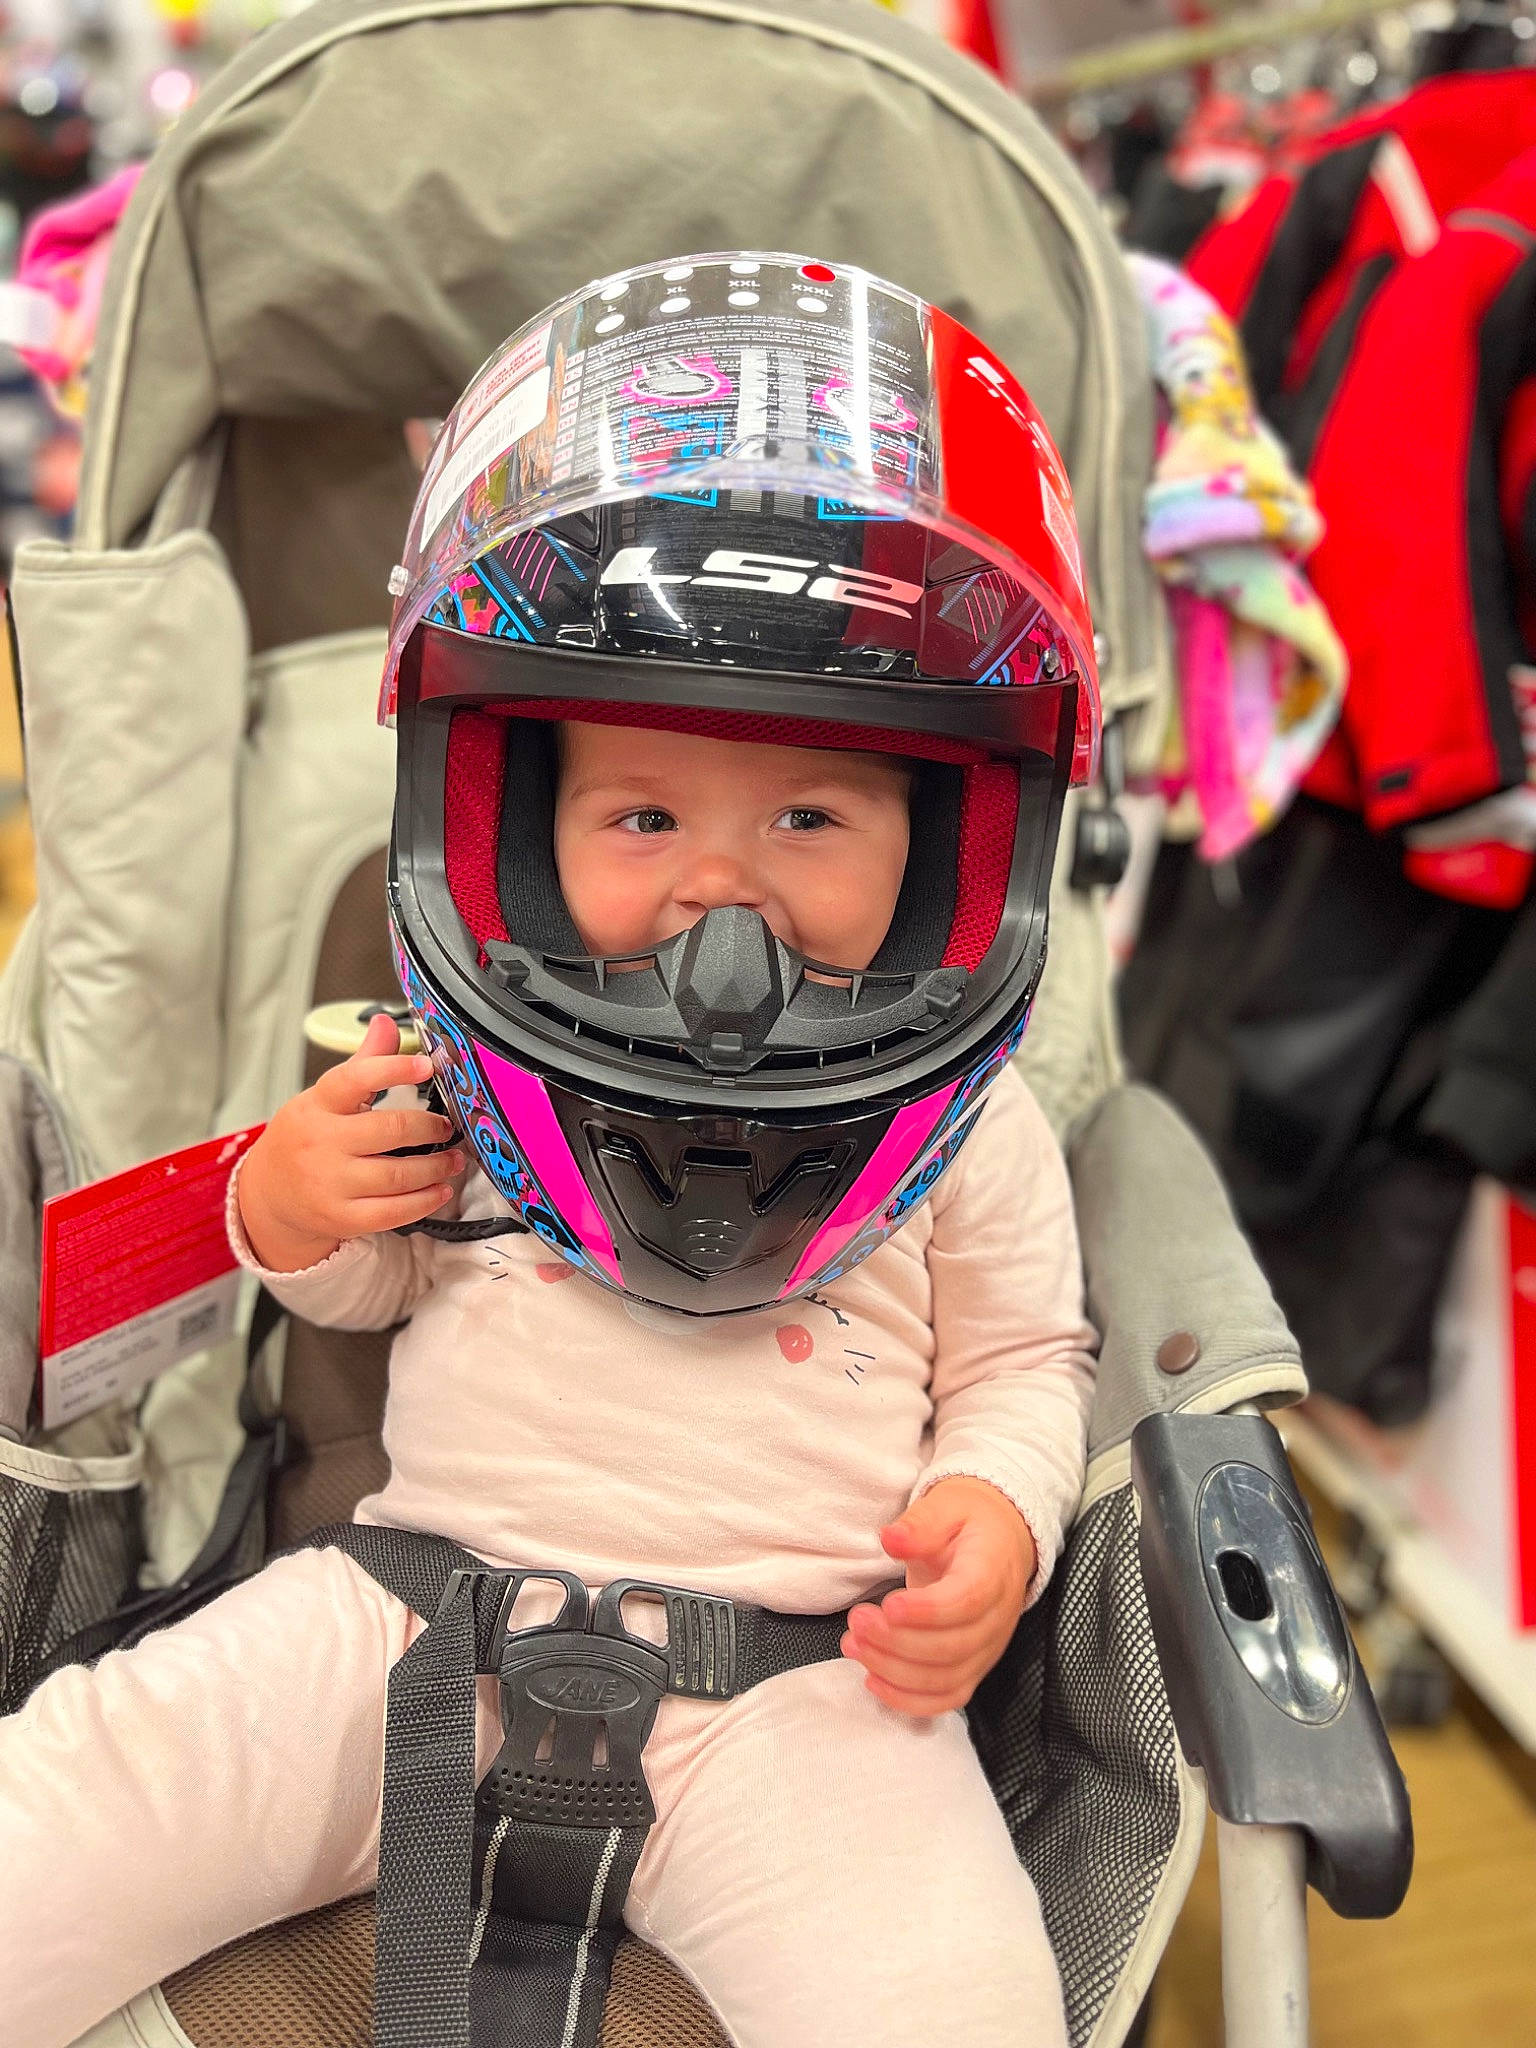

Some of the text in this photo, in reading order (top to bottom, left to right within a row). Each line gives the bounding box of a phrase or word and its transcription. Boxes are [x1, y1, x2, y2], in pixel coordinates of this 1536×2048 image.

[727, 280, 760, 288] XXL
[666, 286, 687, 295] XL
[791, 283, 834, 298] XXXL
[600, 546, 924, 620] LS2
